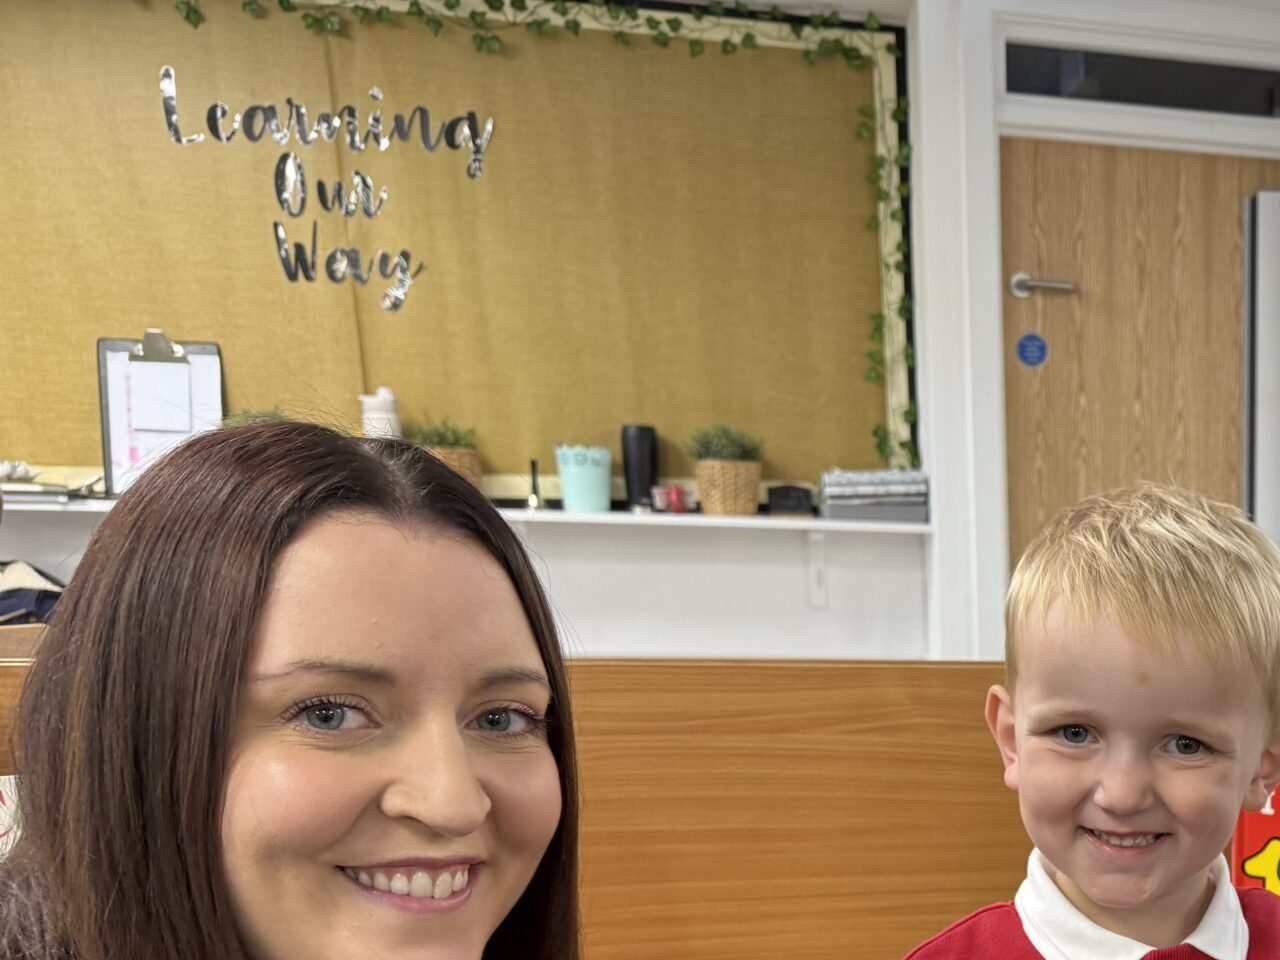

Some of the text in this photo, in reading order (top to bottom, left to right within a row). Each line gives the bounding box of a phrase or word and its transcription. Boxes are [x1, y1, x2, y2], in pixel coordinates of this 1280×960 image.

[159, 65, 494, 180] Learning
[274, 152, 389, 218] Our
[272, 220, 426, 313] Way
[1260, 791, 1276, 815] I
